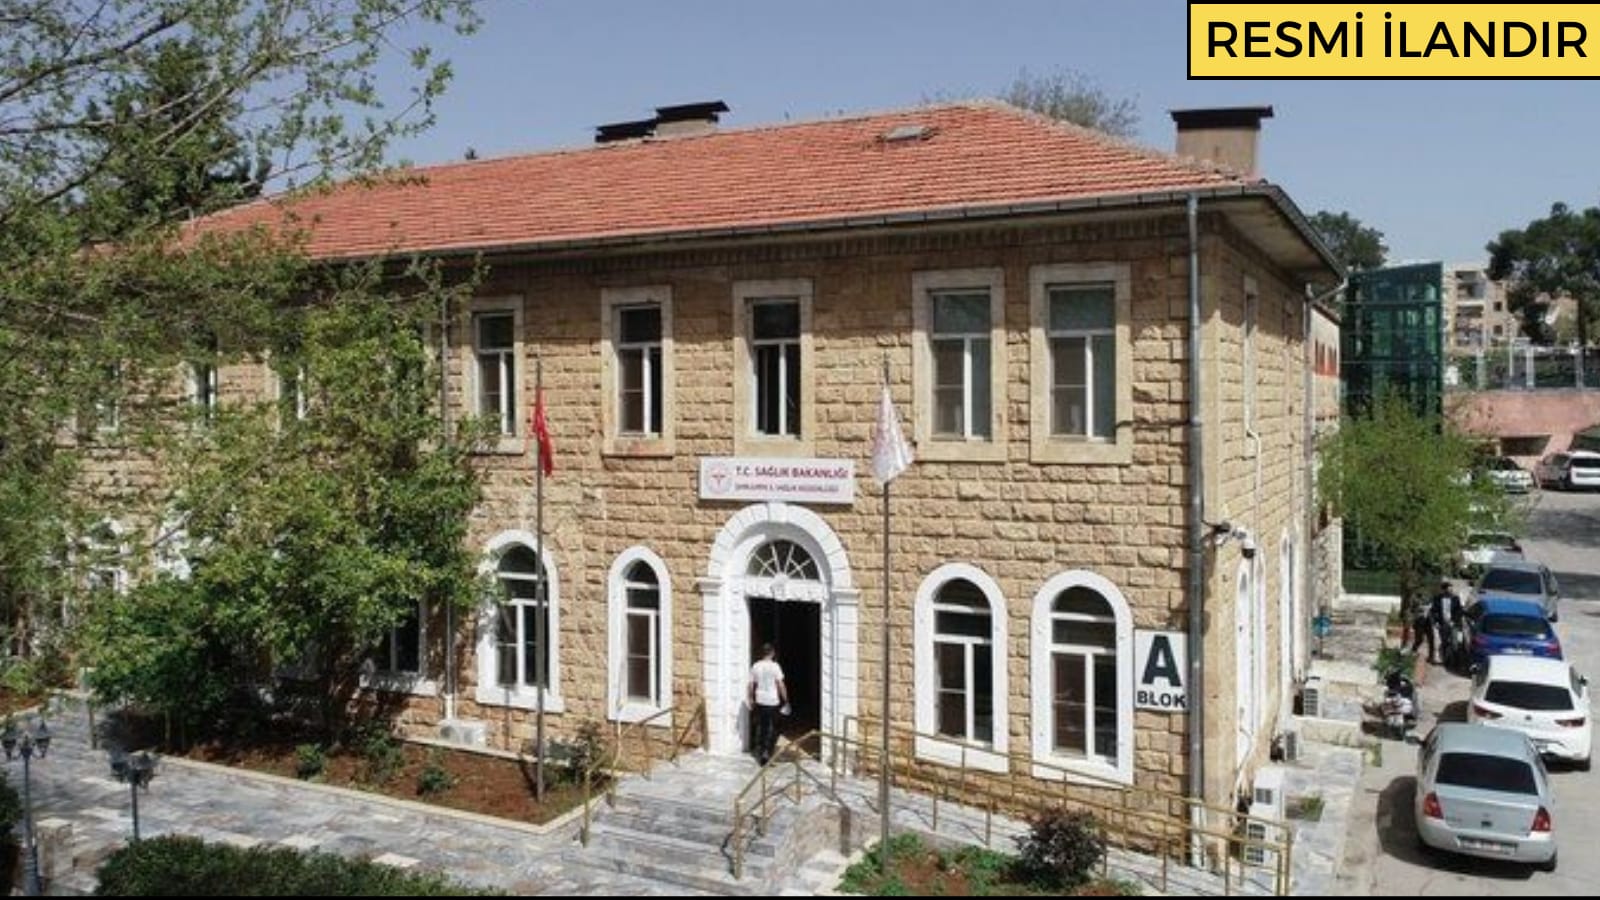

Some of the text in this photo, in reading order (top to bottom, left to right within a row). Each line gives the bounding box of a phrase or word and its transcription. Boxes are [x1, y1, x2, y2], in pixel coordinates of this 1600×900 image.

[755, 466, 789, 477] SAĞLIK
[1142, 634, 1182, 687] A
[1137, 690, 1187, 708] BLOK
